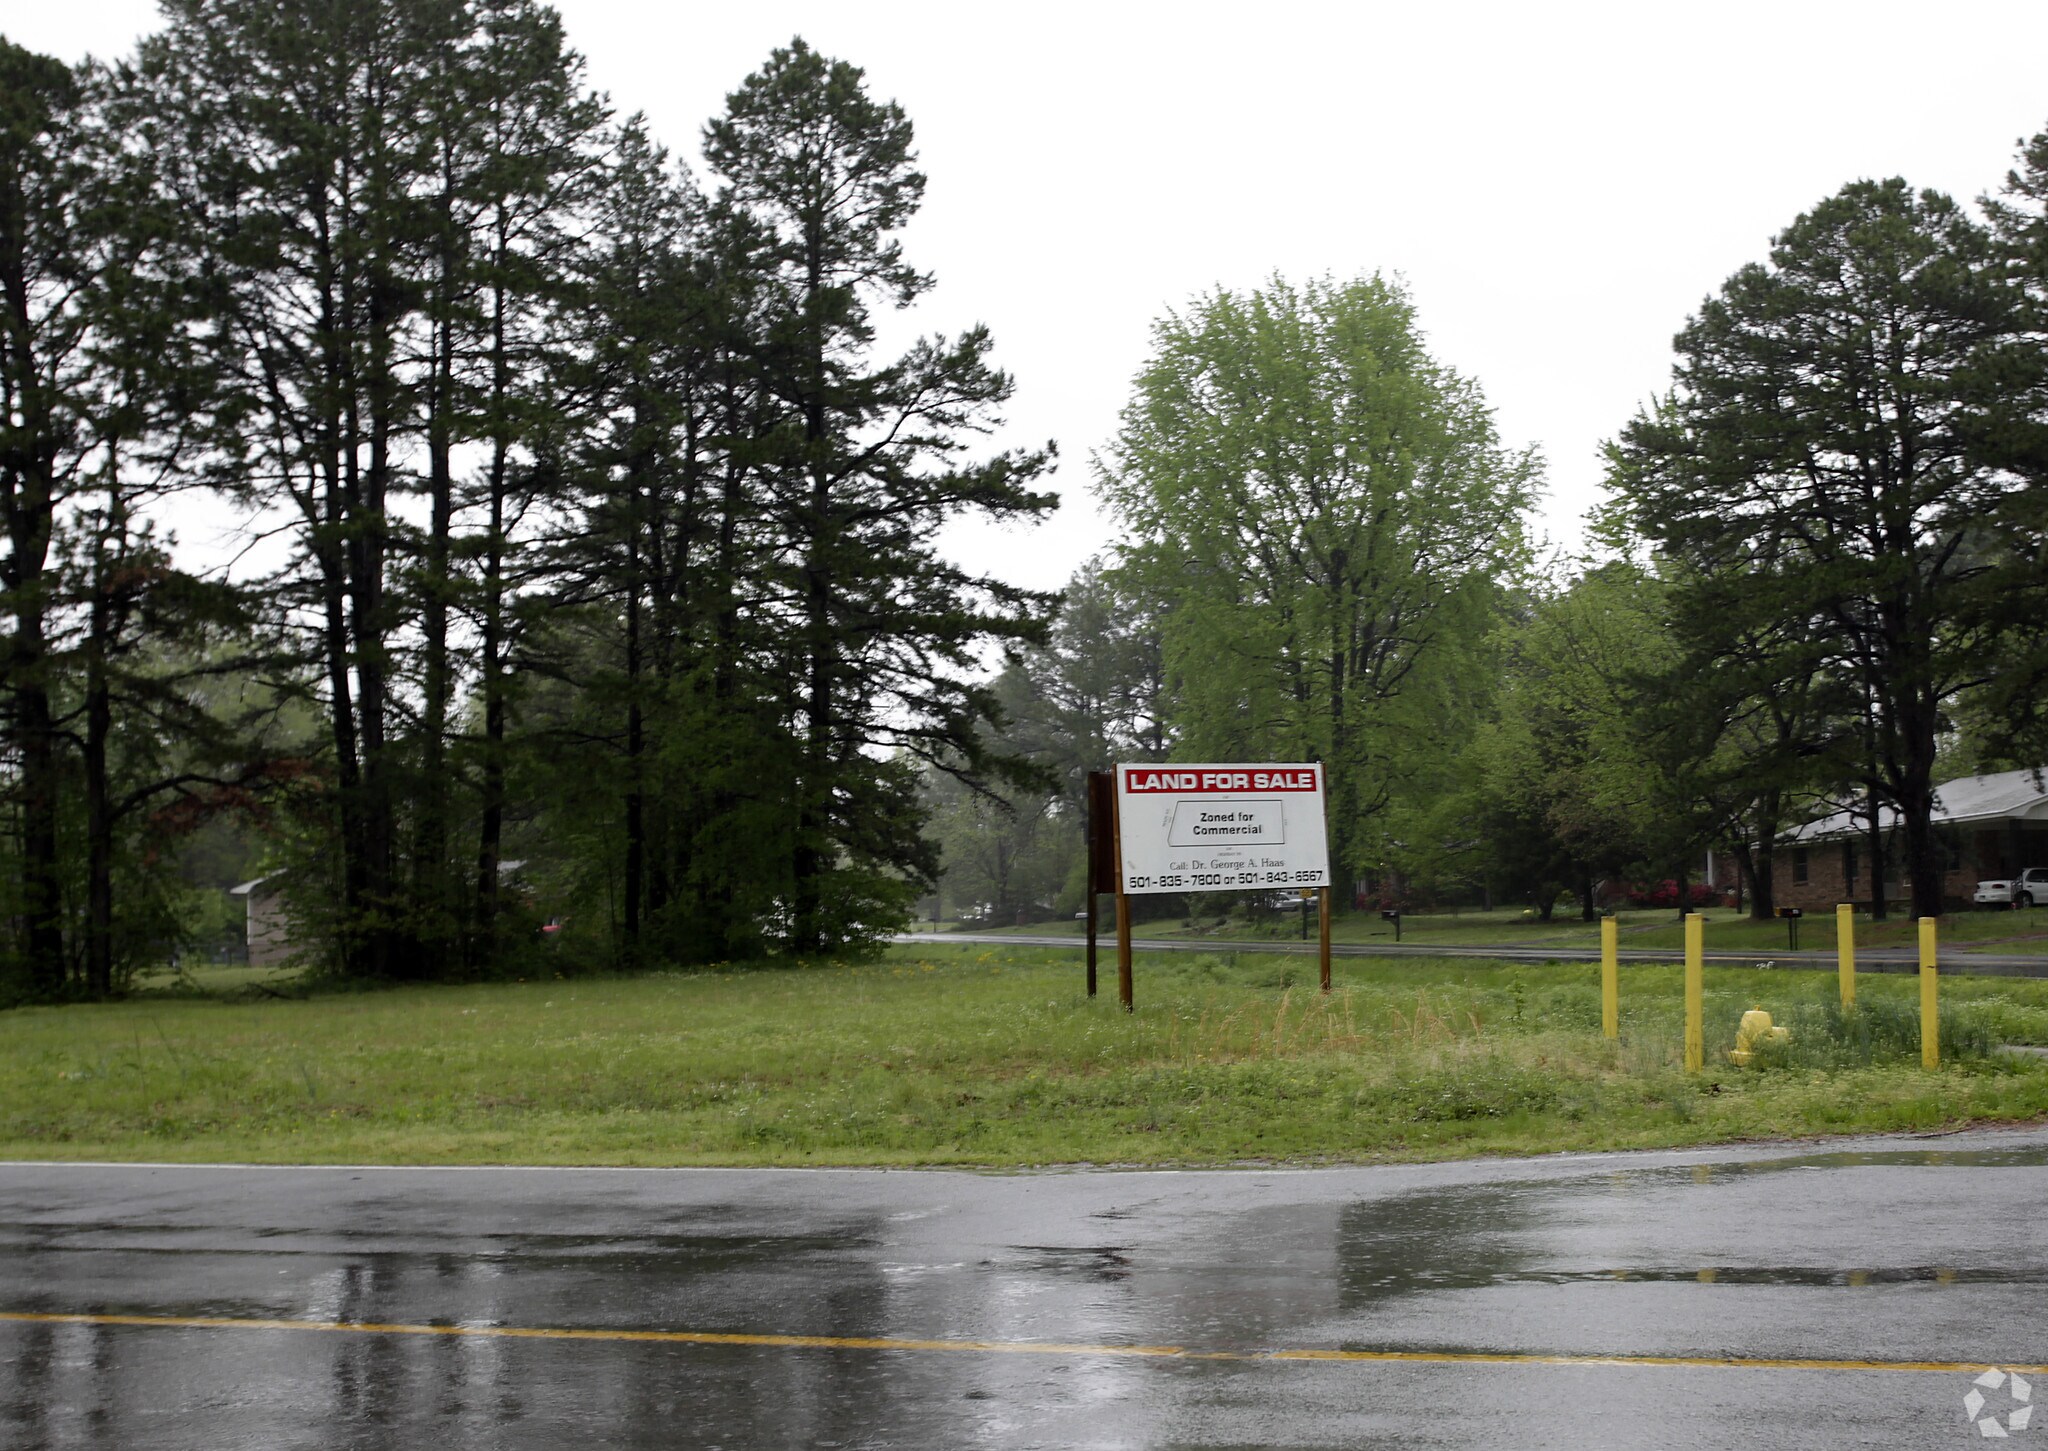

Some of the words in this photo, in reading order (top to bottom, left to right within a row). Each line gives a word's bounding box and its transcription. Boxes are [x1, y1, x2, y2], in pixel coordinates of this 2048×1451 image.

[1130, 773, 1198, 790] LAND
[1202, 773, 1249, 789] FOR
[1253, 773, 1313, 789] SALE
[1200, 812, 1235, 822] Zoned
[1238, 812, 1254, 822] for
[1193, 825, 1262, 835] Commercial
[1169, 861, 1189, 871] Call:
[1192, 860, 1207, 870] Dr.
[1210, 859, 1245, 871] George
[1248, 858, 1258, 868] A.
[1261, 858, 1285, 868] Haas
[1223, 876, 1236, 885] or
